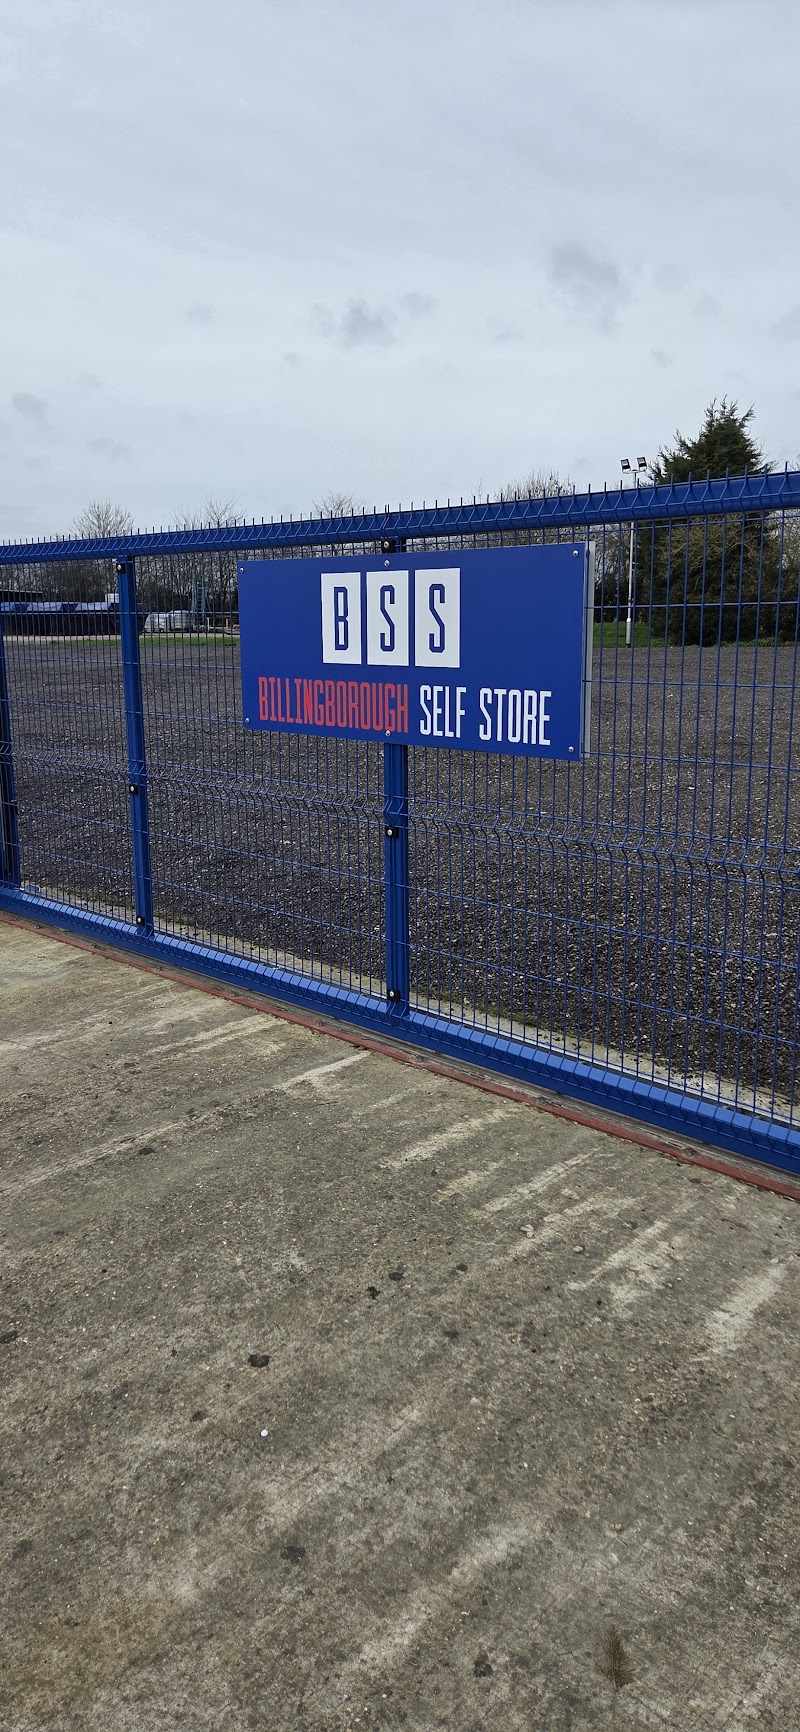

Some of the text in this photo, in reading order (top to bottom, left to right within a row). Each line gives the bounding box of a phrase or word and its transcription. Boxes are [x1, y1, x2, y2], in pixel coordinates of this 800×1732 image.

[333, 583, 446, 654] BSS
[258, 676, 552, 746] BILLINGBOROUGH SELF STORE
